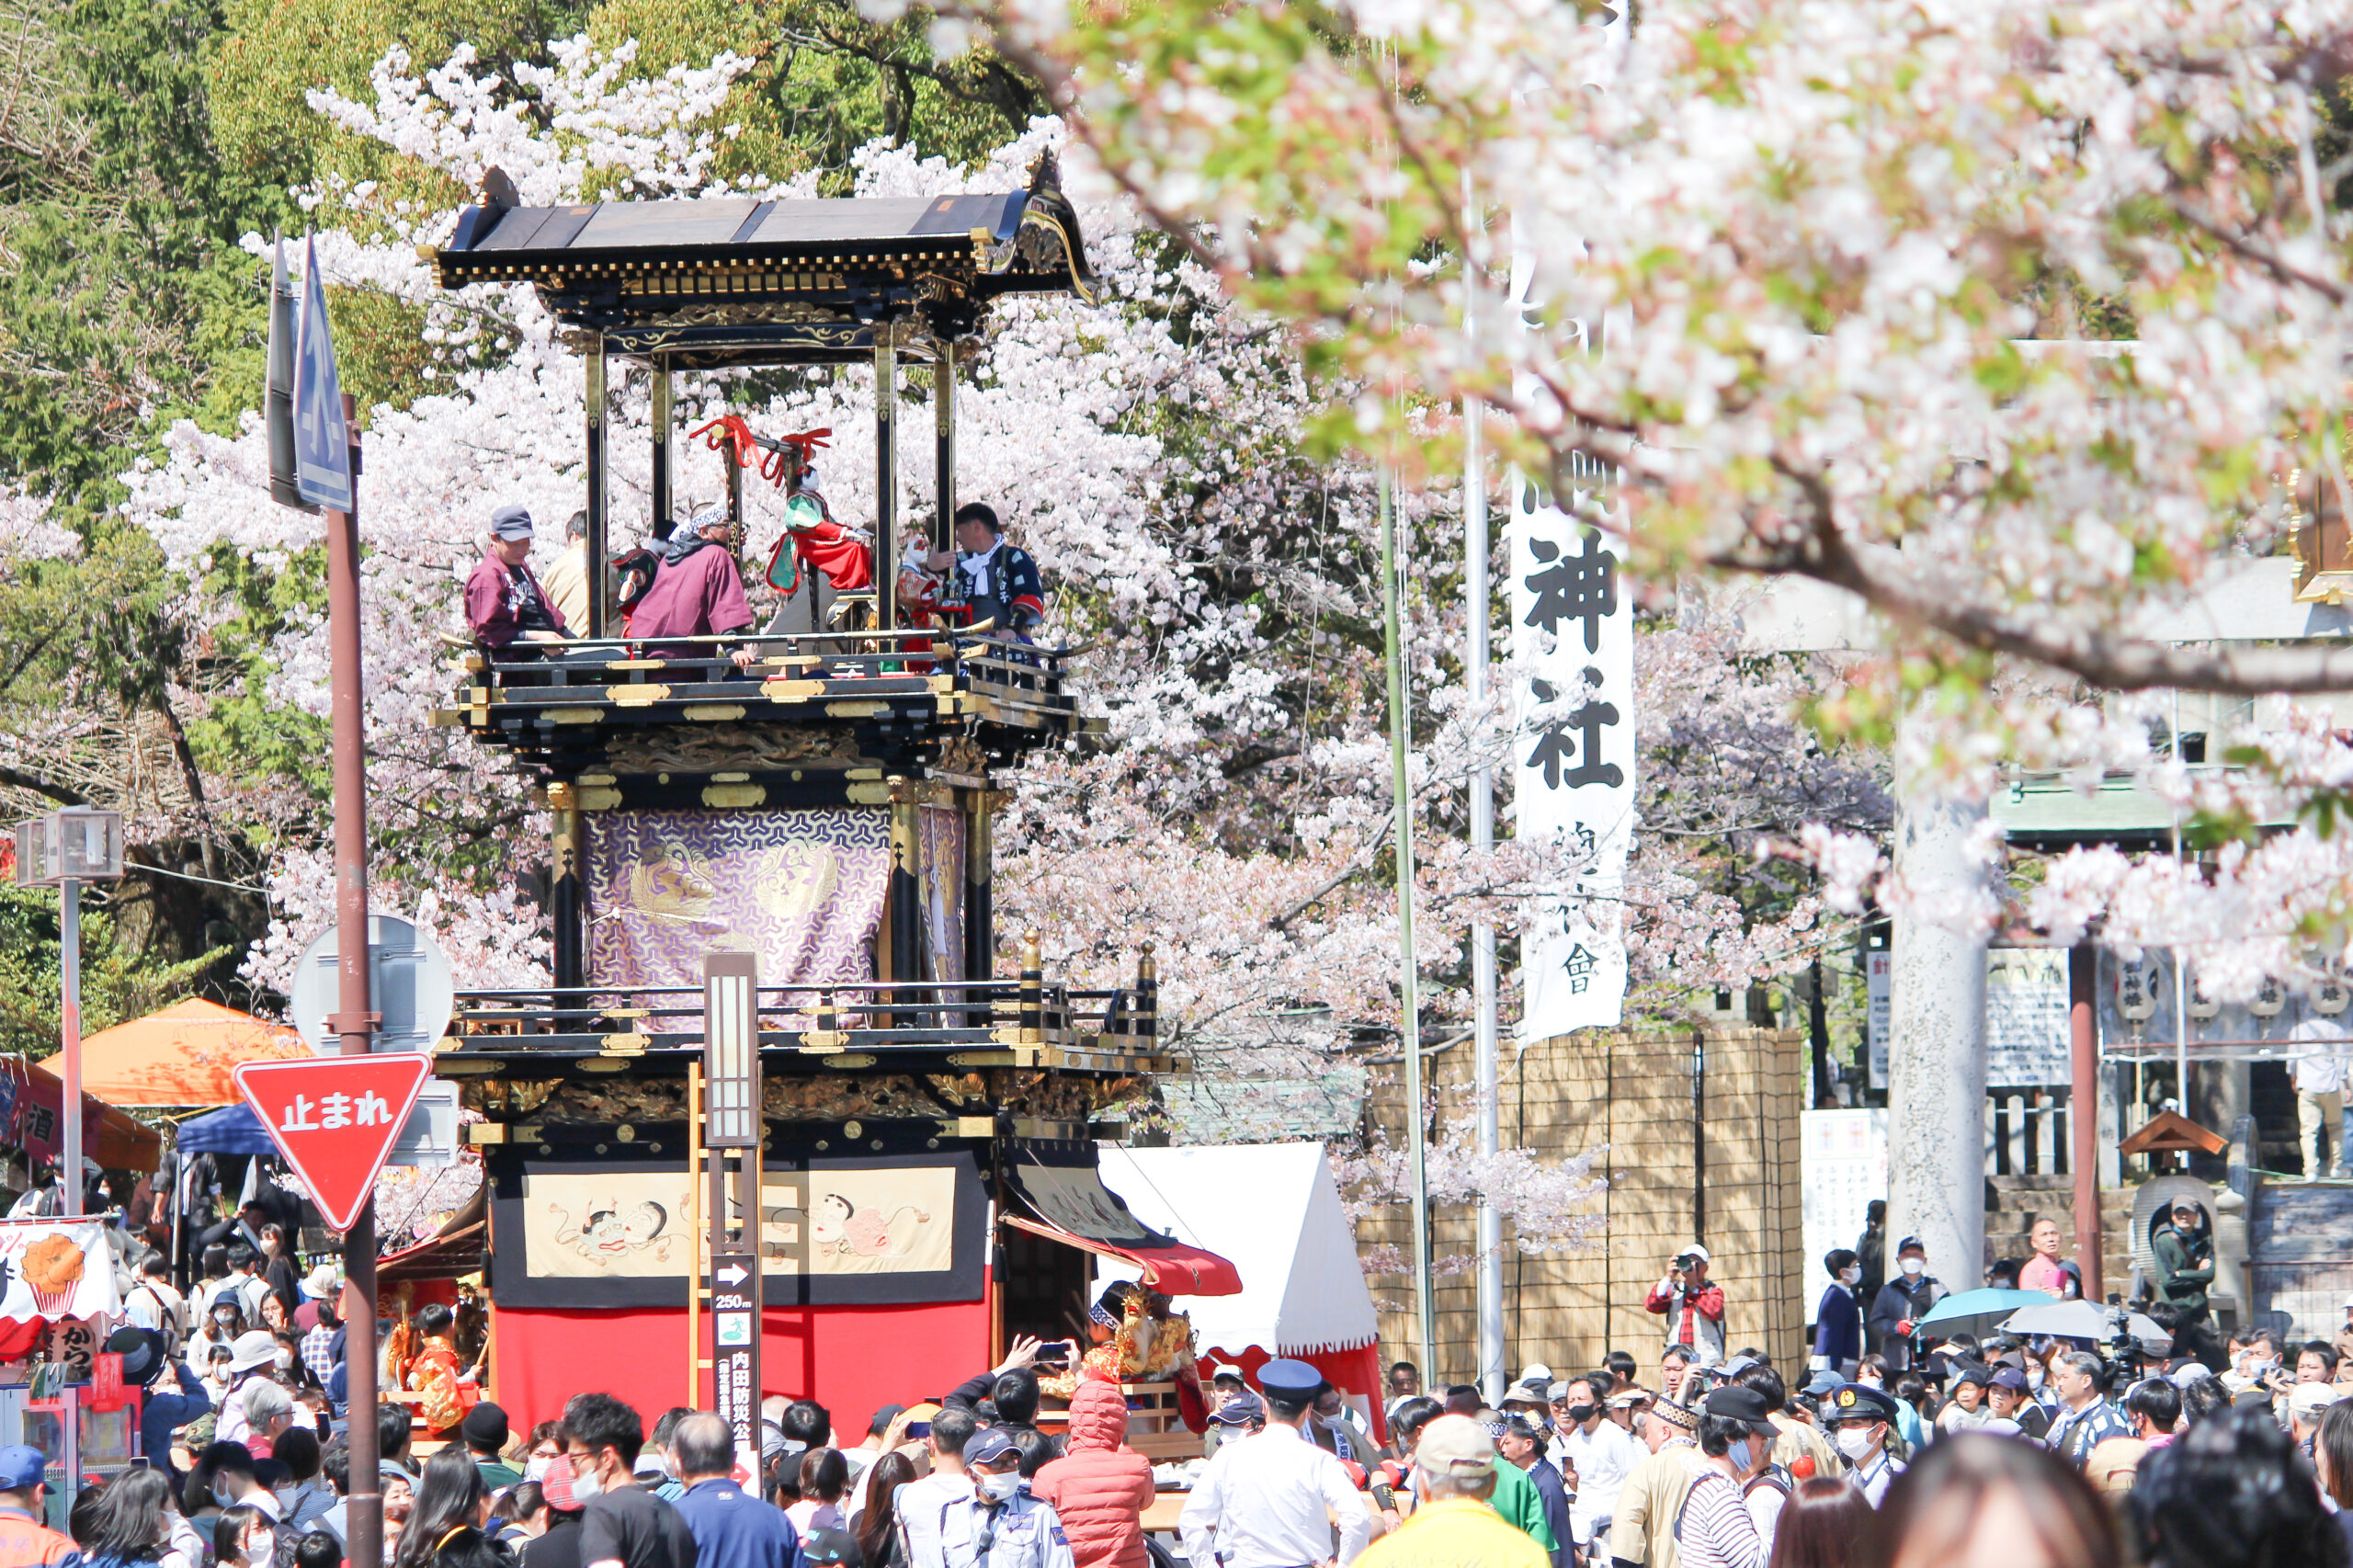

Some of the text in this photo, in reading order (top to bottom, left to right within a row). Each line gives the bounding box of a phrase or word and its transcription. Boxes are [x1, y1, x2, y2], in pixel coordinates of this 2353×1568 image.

[27, 1103, 55, 1143] 酒
[279, 1089, 393, 1132] 止まれ
[715, 1294, 752, 1310] 250m
[62, 1326, 91, 1368] から
